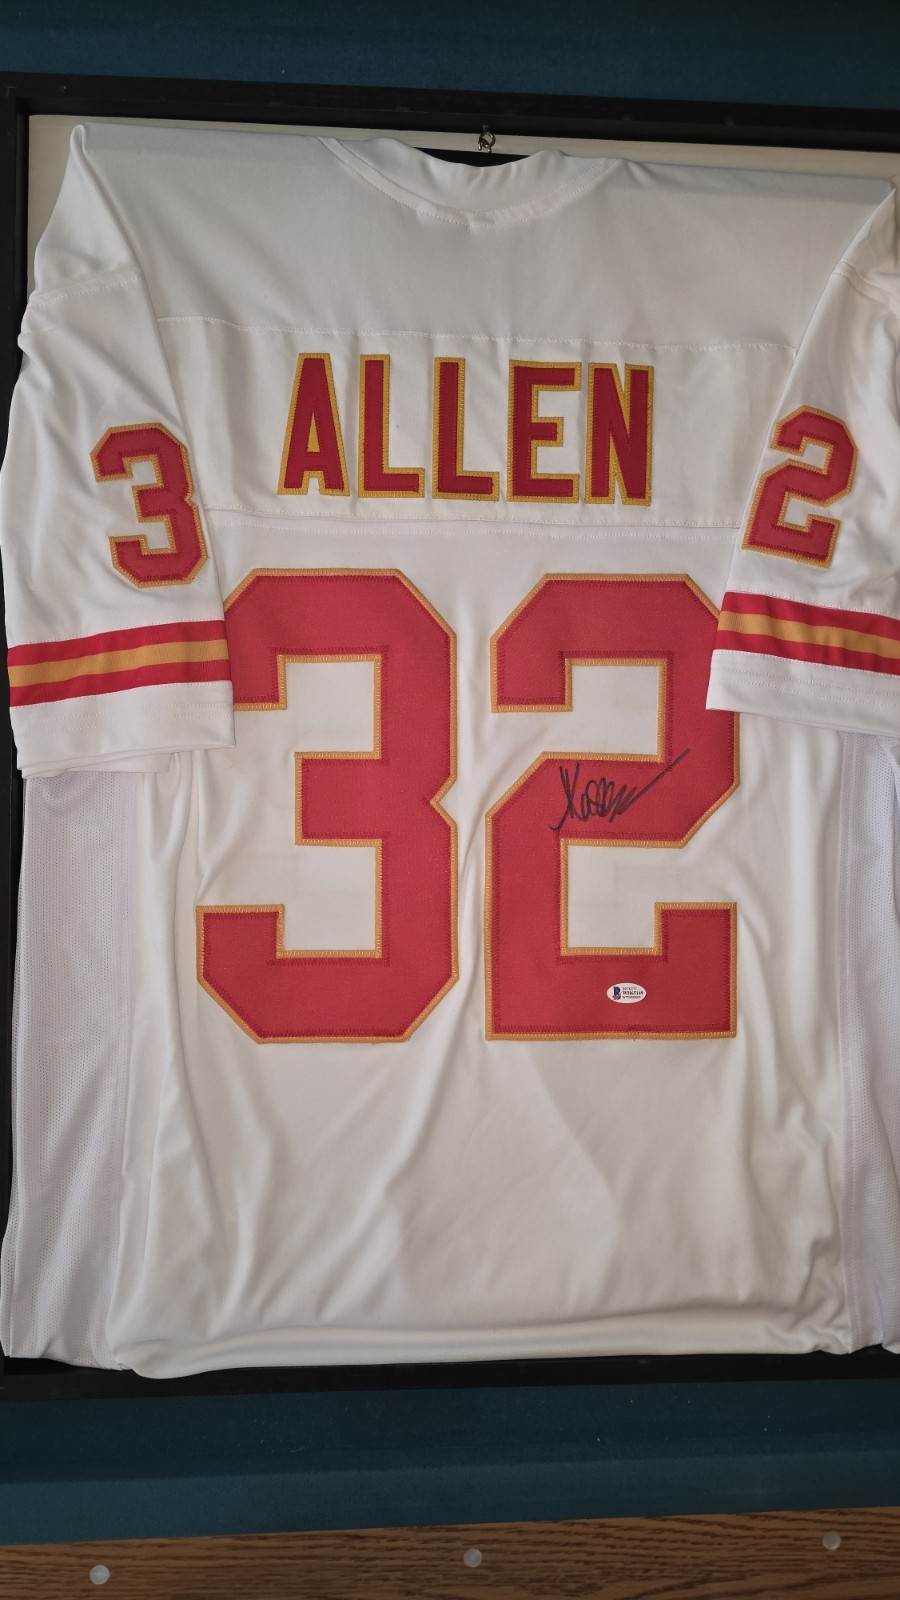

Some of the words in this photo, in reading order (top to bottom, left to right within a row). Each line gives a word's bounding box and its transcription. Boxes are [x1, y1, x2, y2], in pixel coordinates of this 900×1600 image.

[91, 423, 208, 586] 3
[278, 353, 654, 506] ALLEN
[742, 406, 858, 567] 2
[197, 569, 738, 1043] 32
